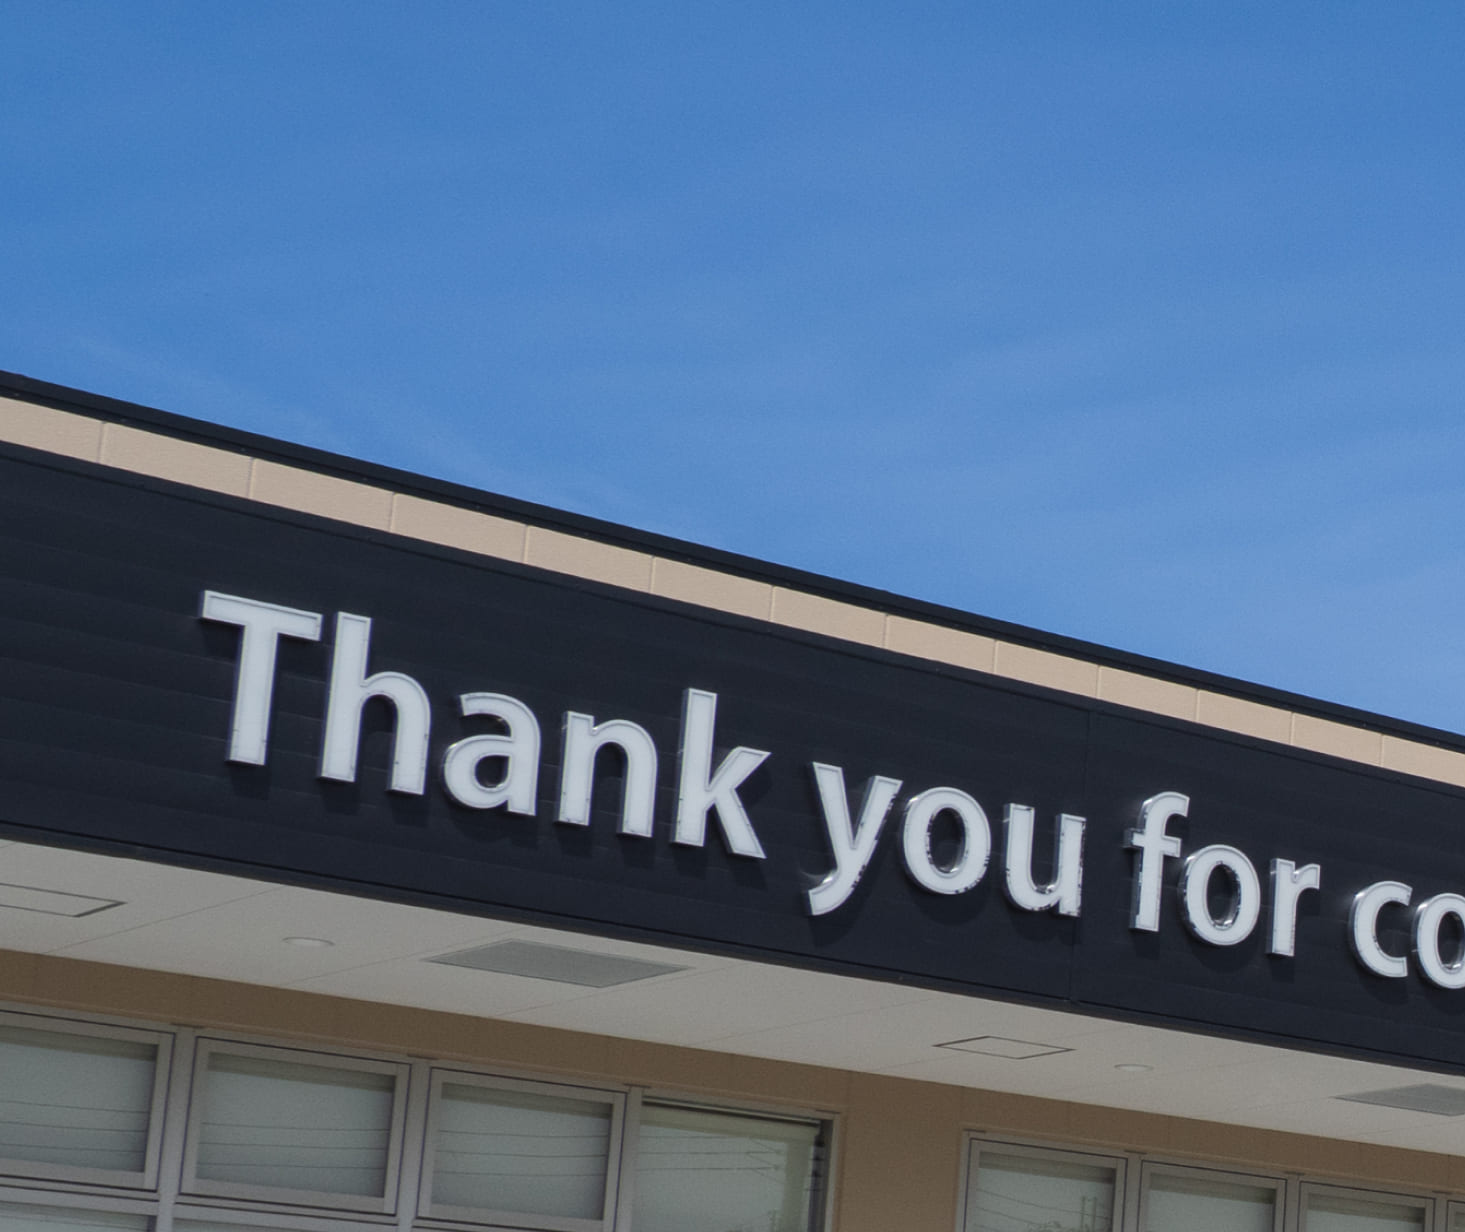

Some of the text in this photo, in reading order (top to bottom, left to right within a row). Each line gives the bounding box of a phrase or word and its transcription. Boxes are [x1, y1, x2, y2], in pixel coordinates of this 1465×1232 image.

[202, 589, 770, 859] Thank
[808, 761, 1087, 917] you
[1125, 791, 1320, 957] for
